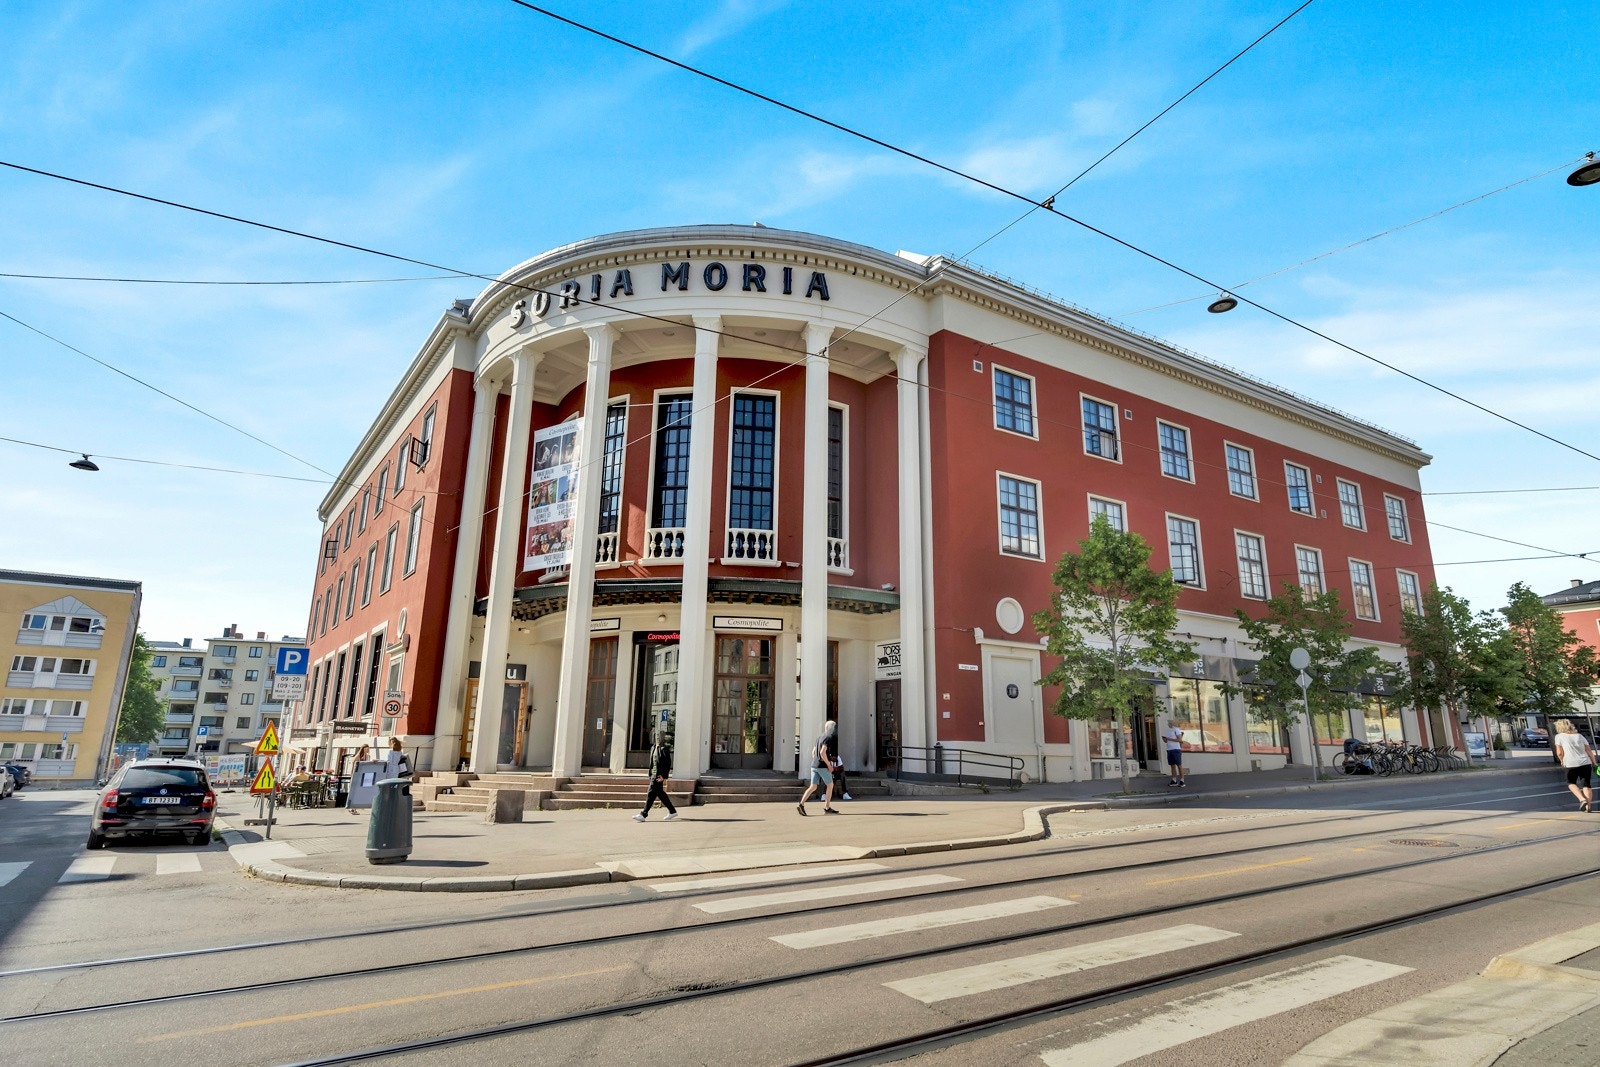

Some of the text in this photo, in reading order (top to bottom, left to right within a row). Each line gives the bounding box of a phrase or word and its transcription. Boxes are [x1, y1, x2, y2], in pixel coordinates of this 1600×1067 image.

[510, 261, 830, 329] SORIA MORIA
[727, 618, 769, 627] Cosmopolite
[284, 651, 302, 671] P
[387, 703, 399, 712] 30
[199, 727, 206, 735] P
